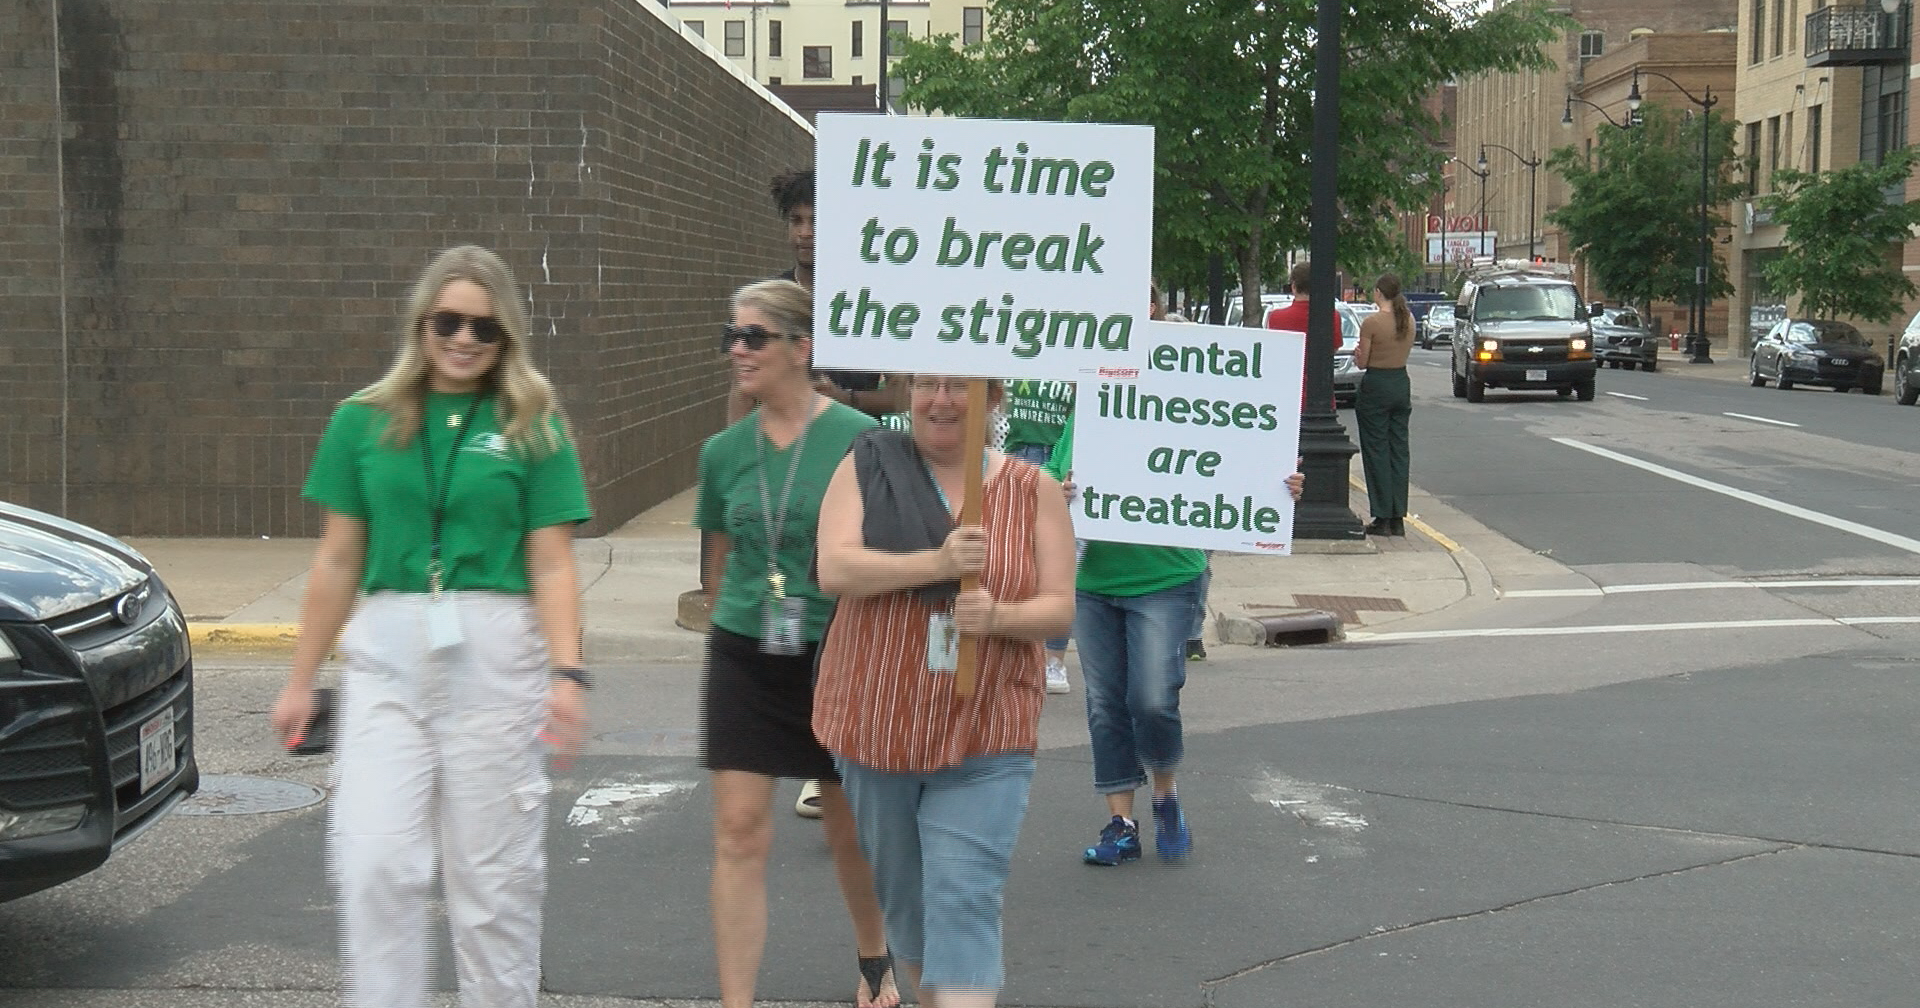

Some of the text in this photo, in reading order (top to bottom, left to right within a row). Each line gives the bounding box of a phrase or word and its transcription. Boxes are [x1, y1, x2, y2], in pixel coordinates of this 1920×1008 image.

[852, 138, 1115, 198] It is time
[860, 216, 1105, 274] to break
[1427, 215, 1488, 233] RVOLI
[828, 287, 1133, 360] the stigma
[1148, 341, 1262, 379] ental
[1014, 397, 1039, 409] MENTAL
[1038, 380, 1072, 403] FOR
[1098, 383, 1278, 431] illnesses
[1147, 446, 1221, 477] are
[1082, 486, 1281, 533] treatable
